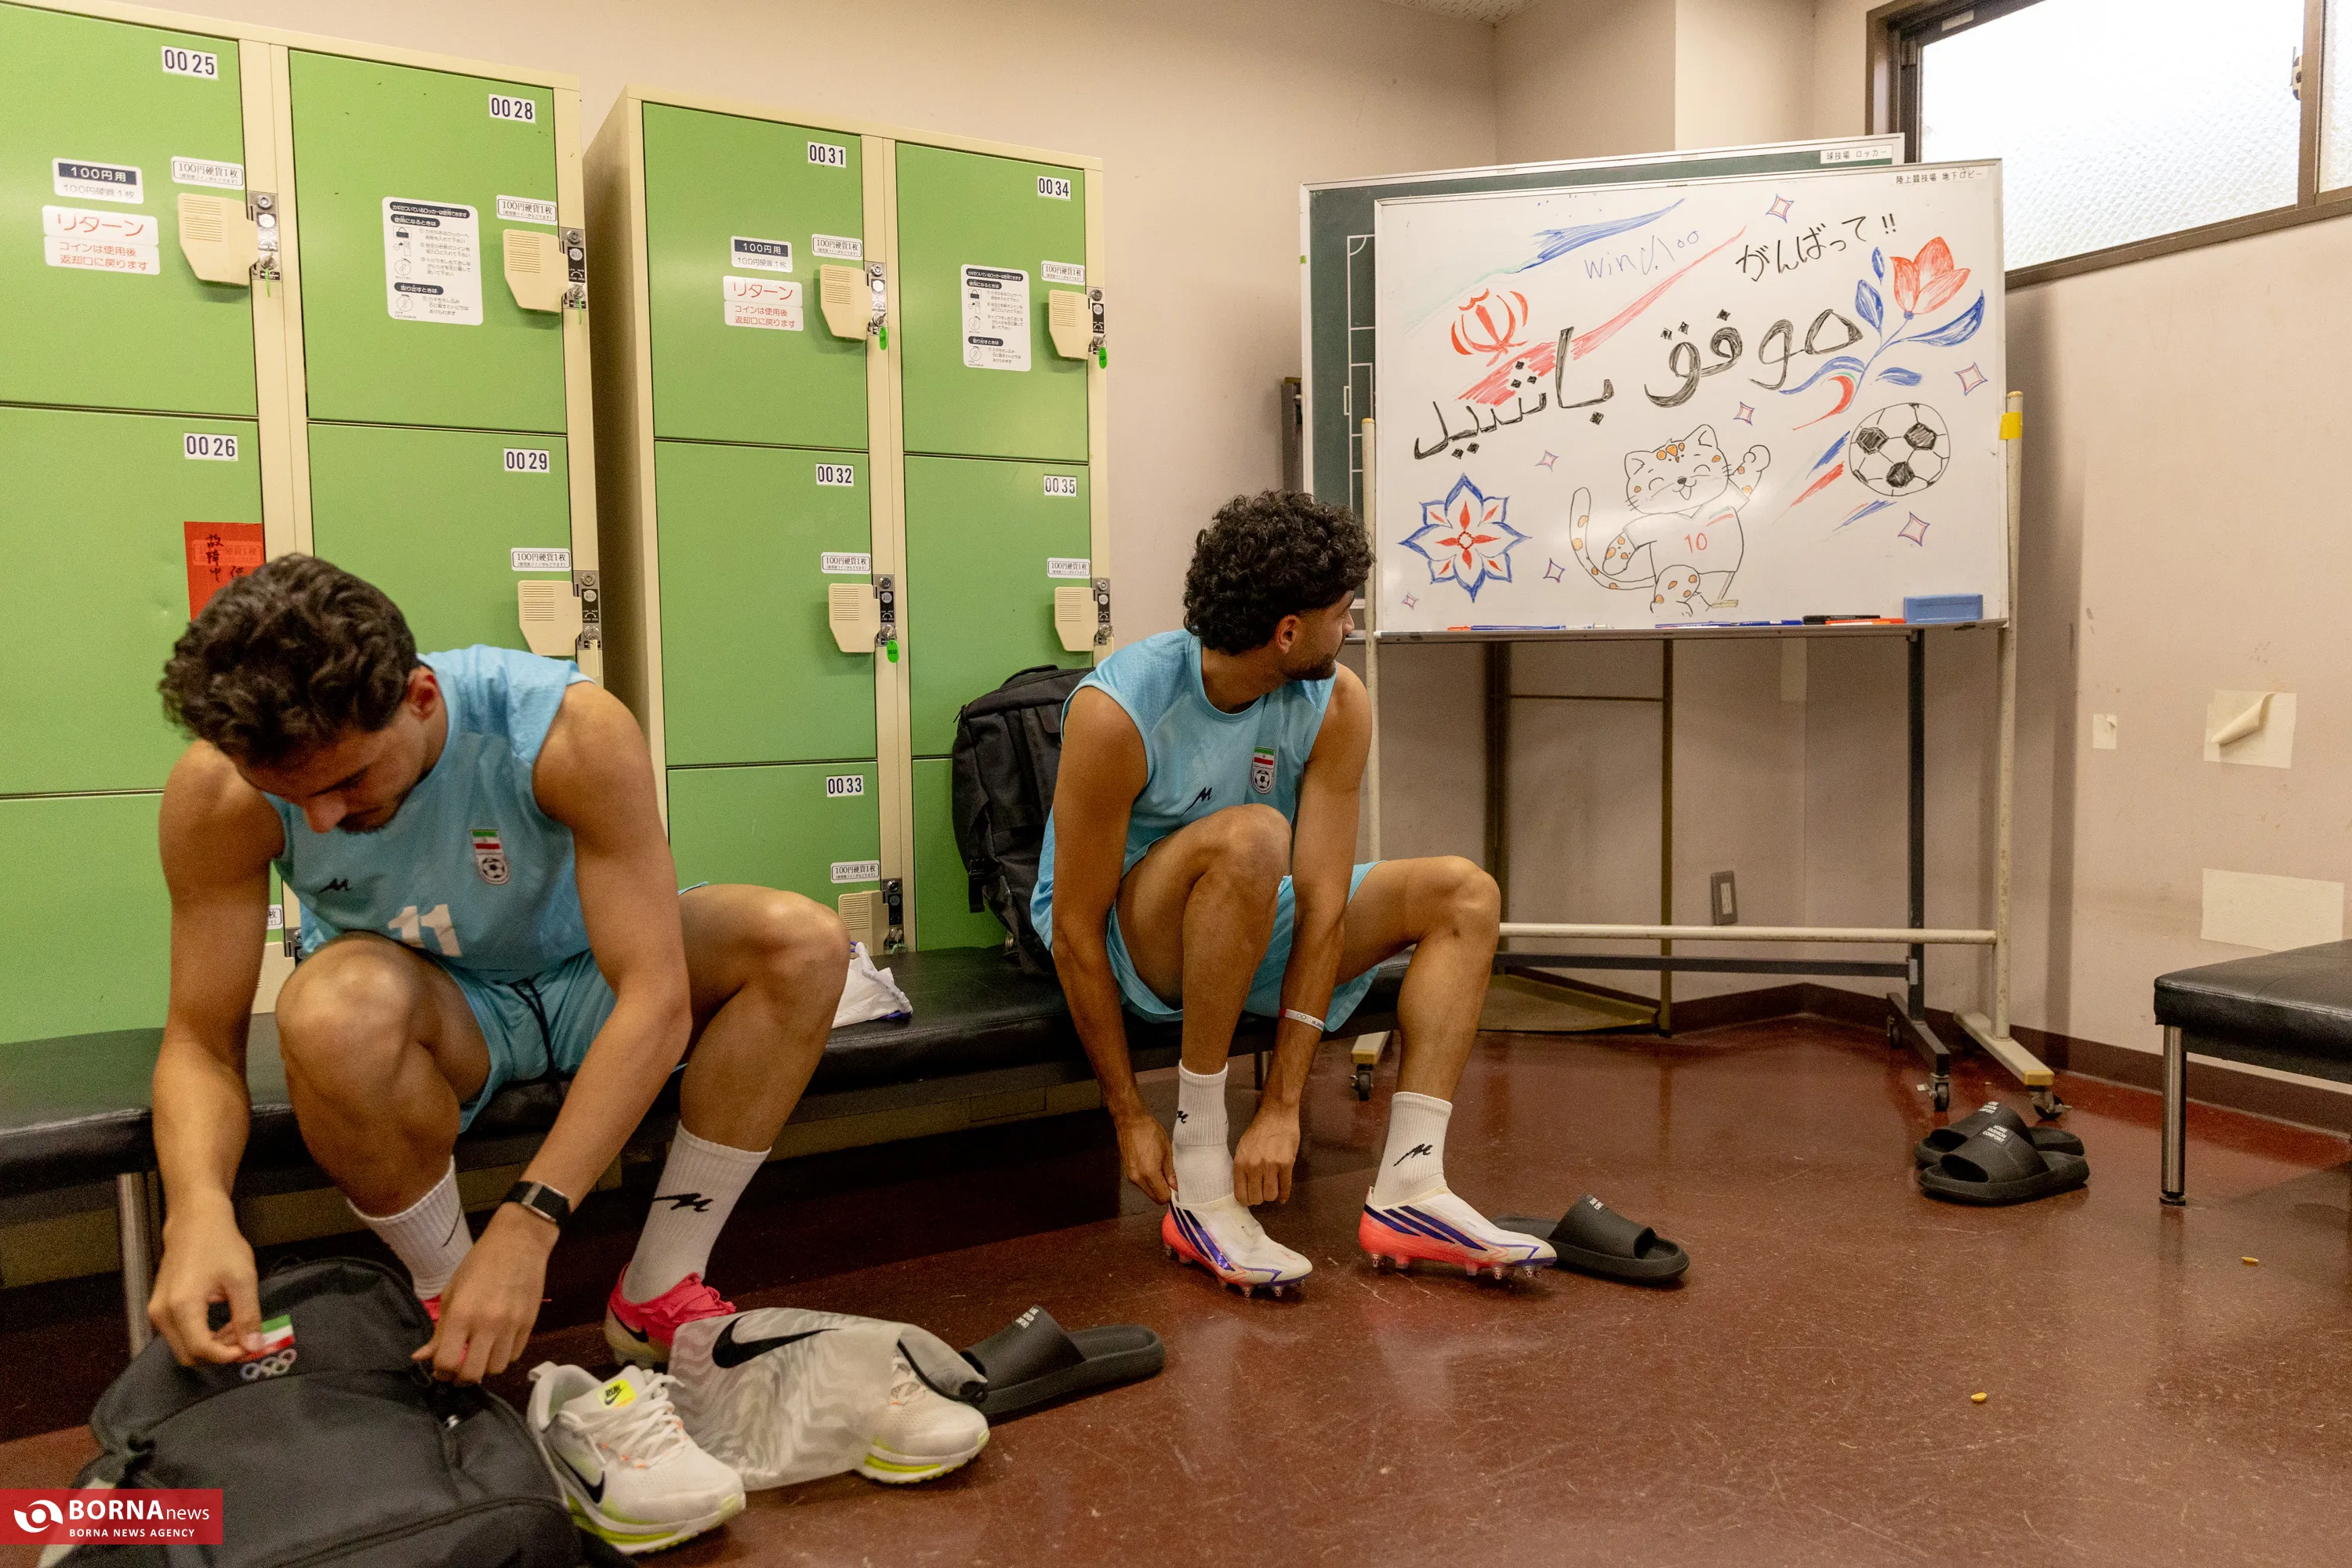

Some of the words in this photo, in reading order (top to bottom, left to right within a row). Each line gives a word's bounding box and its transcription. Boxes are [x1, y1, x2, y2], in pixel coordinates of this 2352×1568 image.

[165, 49, 215, 75] 0025
[491, 97, 533, 120] 0028
[809, 144, 844, 165] 0031
[1826, 151, 1849, 161] 球技場
[1856, 149, 1887, 158] ロッカー
[71, 165, 127, 183] 100円用
[179, 162, 238, 179] 100円硬貨1枚
[1038, 178, 1069, 197] 0034
[502, 201, 553, 215] 100円硬貨1枚
[57, 213, 144, 237] リターン
[59, 241, 136, 257] コインは使用後
[742, 242, 781, 255] 100円用
[816, 239, 858, 252] 100円硬貨1枚
[60, 253, 149, 271] 返却口に戻ります
[733, 281, 793, 300] リターン
[735, 305, 788, 318] コインは使用後
[735, 315, 796, 328] 返却口に戻ります
[186, 435, 236, 457] 0026
[506, 451, 547, 470] 0029
[818, 466, 852, 484] 0032
[1045, 477, 1076, 494] 0035
[1684, 532, 1708, 554] 10
[517, 553, 566, 561] 100円硬貨1枚
[826, 556, 867, 565] 100円硬貨1枚
[1051, 561, 1087, 571] 100円硬貨1枚
[828, 777, 862, 794] 0033
[835, 866, 876, 875] 100円硬貨1枚
[388, 903, 462, 958] 11
